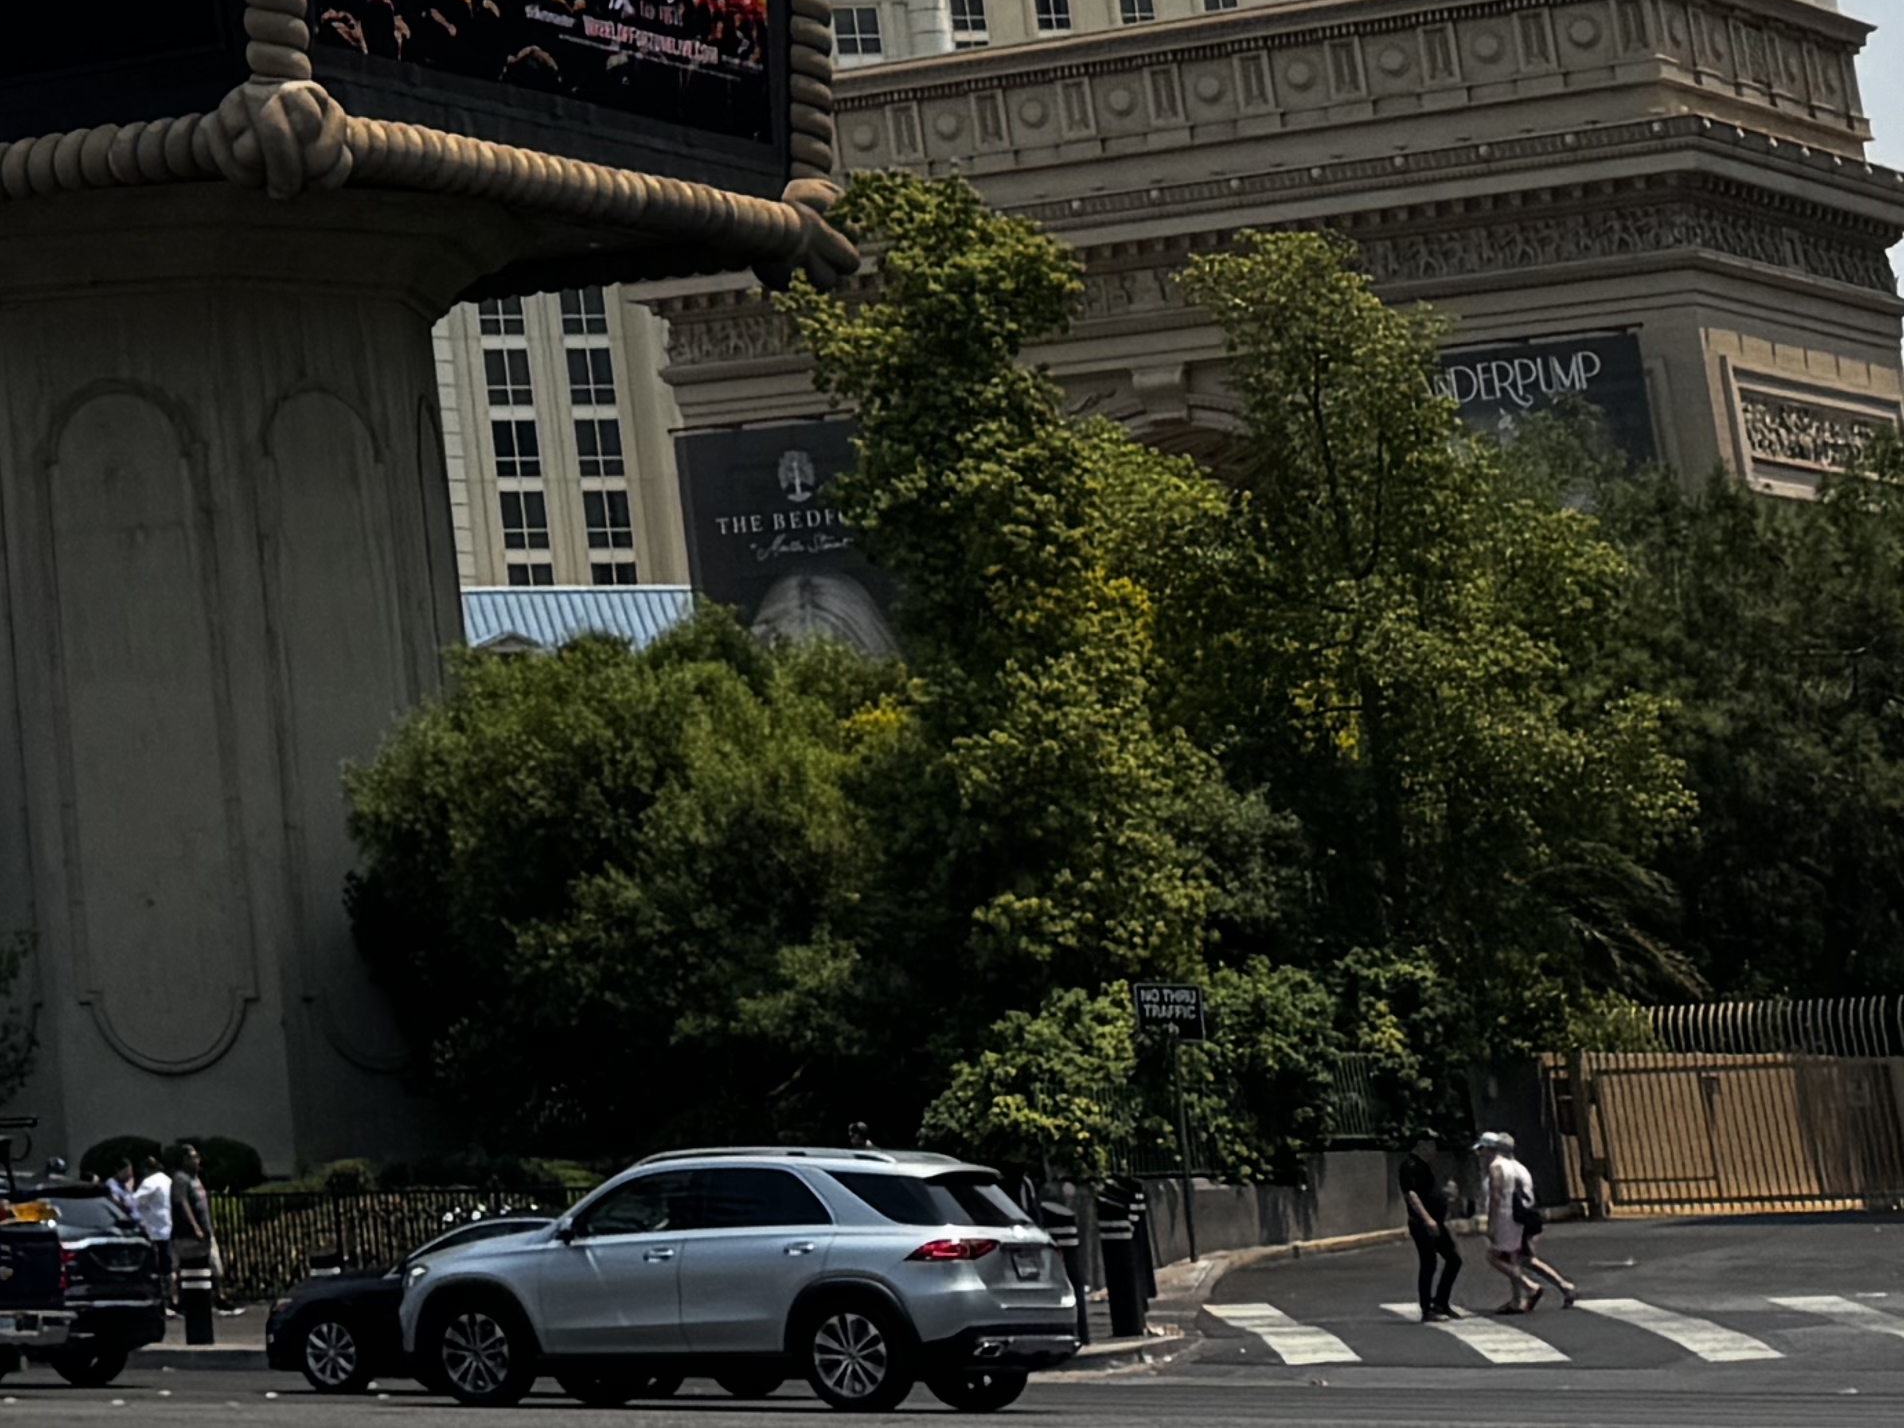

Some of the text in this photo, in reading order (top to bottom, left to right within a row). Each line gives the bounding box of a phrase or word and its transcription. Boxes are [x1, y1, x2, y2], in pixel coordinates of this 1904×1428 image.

[1418, 351, 1602, 408] NDERPUMP
[715, 508, 844, 535] THE BEDF
[1140, 988, 1160, 1003] NO
[1143, 1004, 1196, 1020] TRAFFIC
